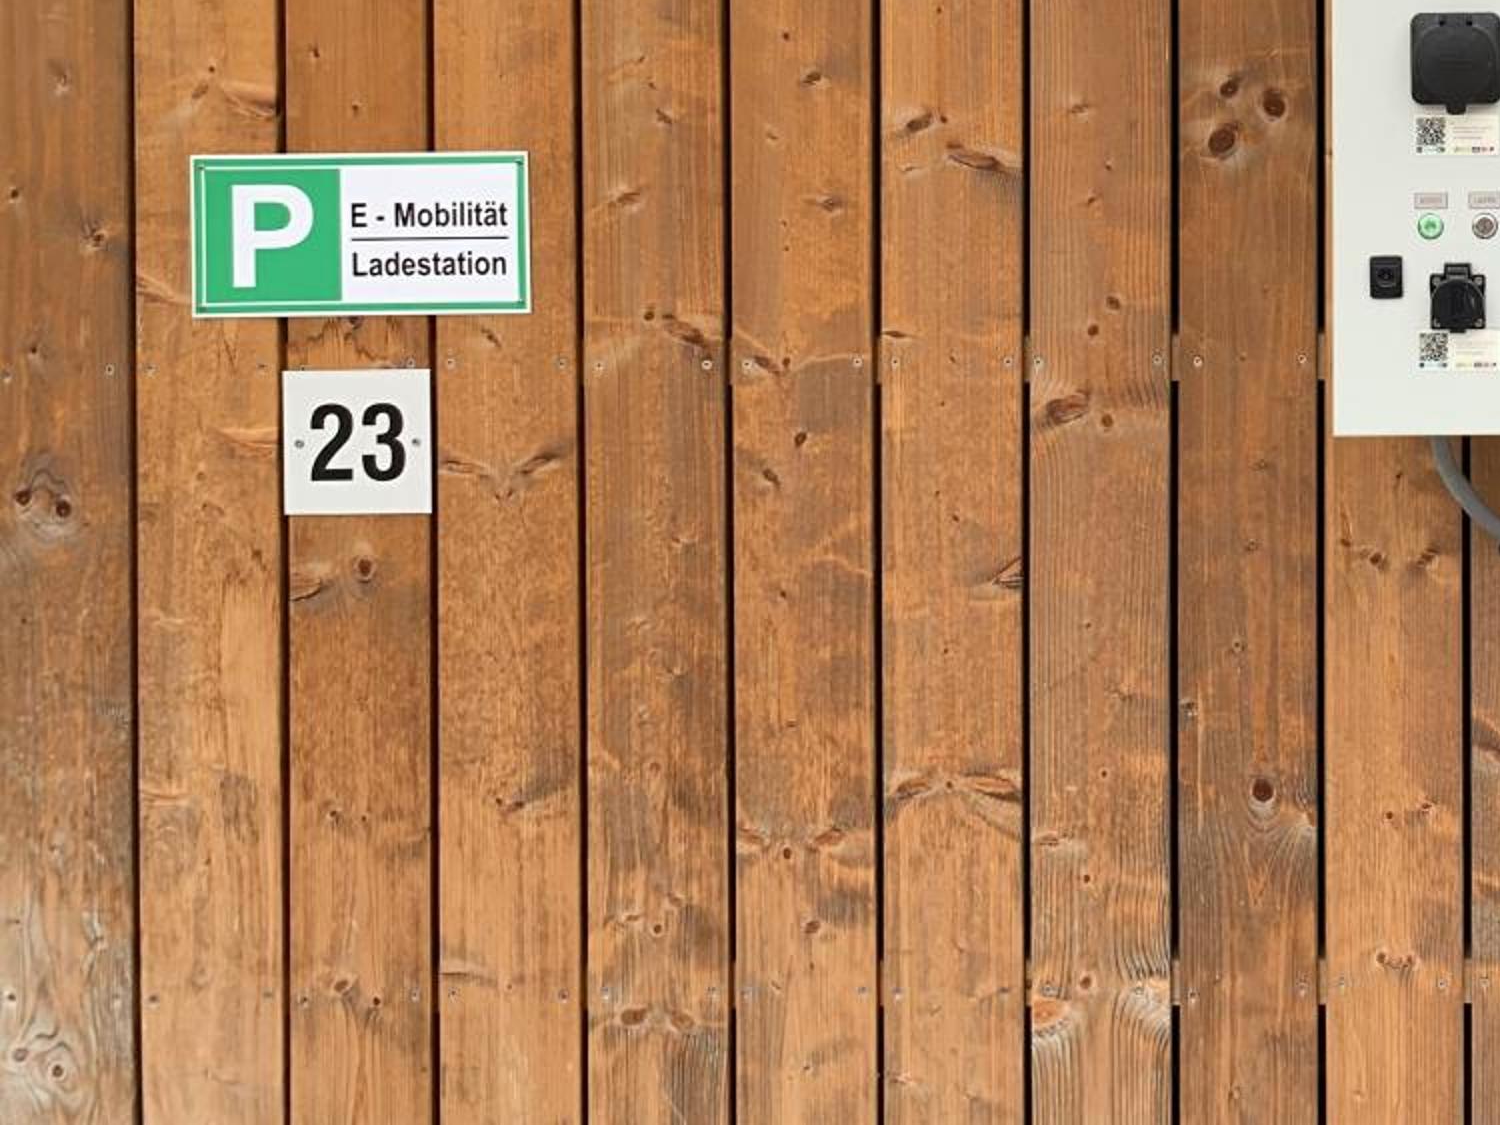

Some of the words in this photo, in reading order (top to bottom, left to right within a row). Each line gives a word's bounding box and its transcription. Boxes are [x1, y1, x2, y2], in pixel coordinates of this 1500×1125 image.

[231, 184, 314, 288] P
[351, 203, 367, 228] E
[394, 201, 508, 227] Mobilität
[352, 251, 508, 277] Ladestation
[310, 402, 406, 482] 23
